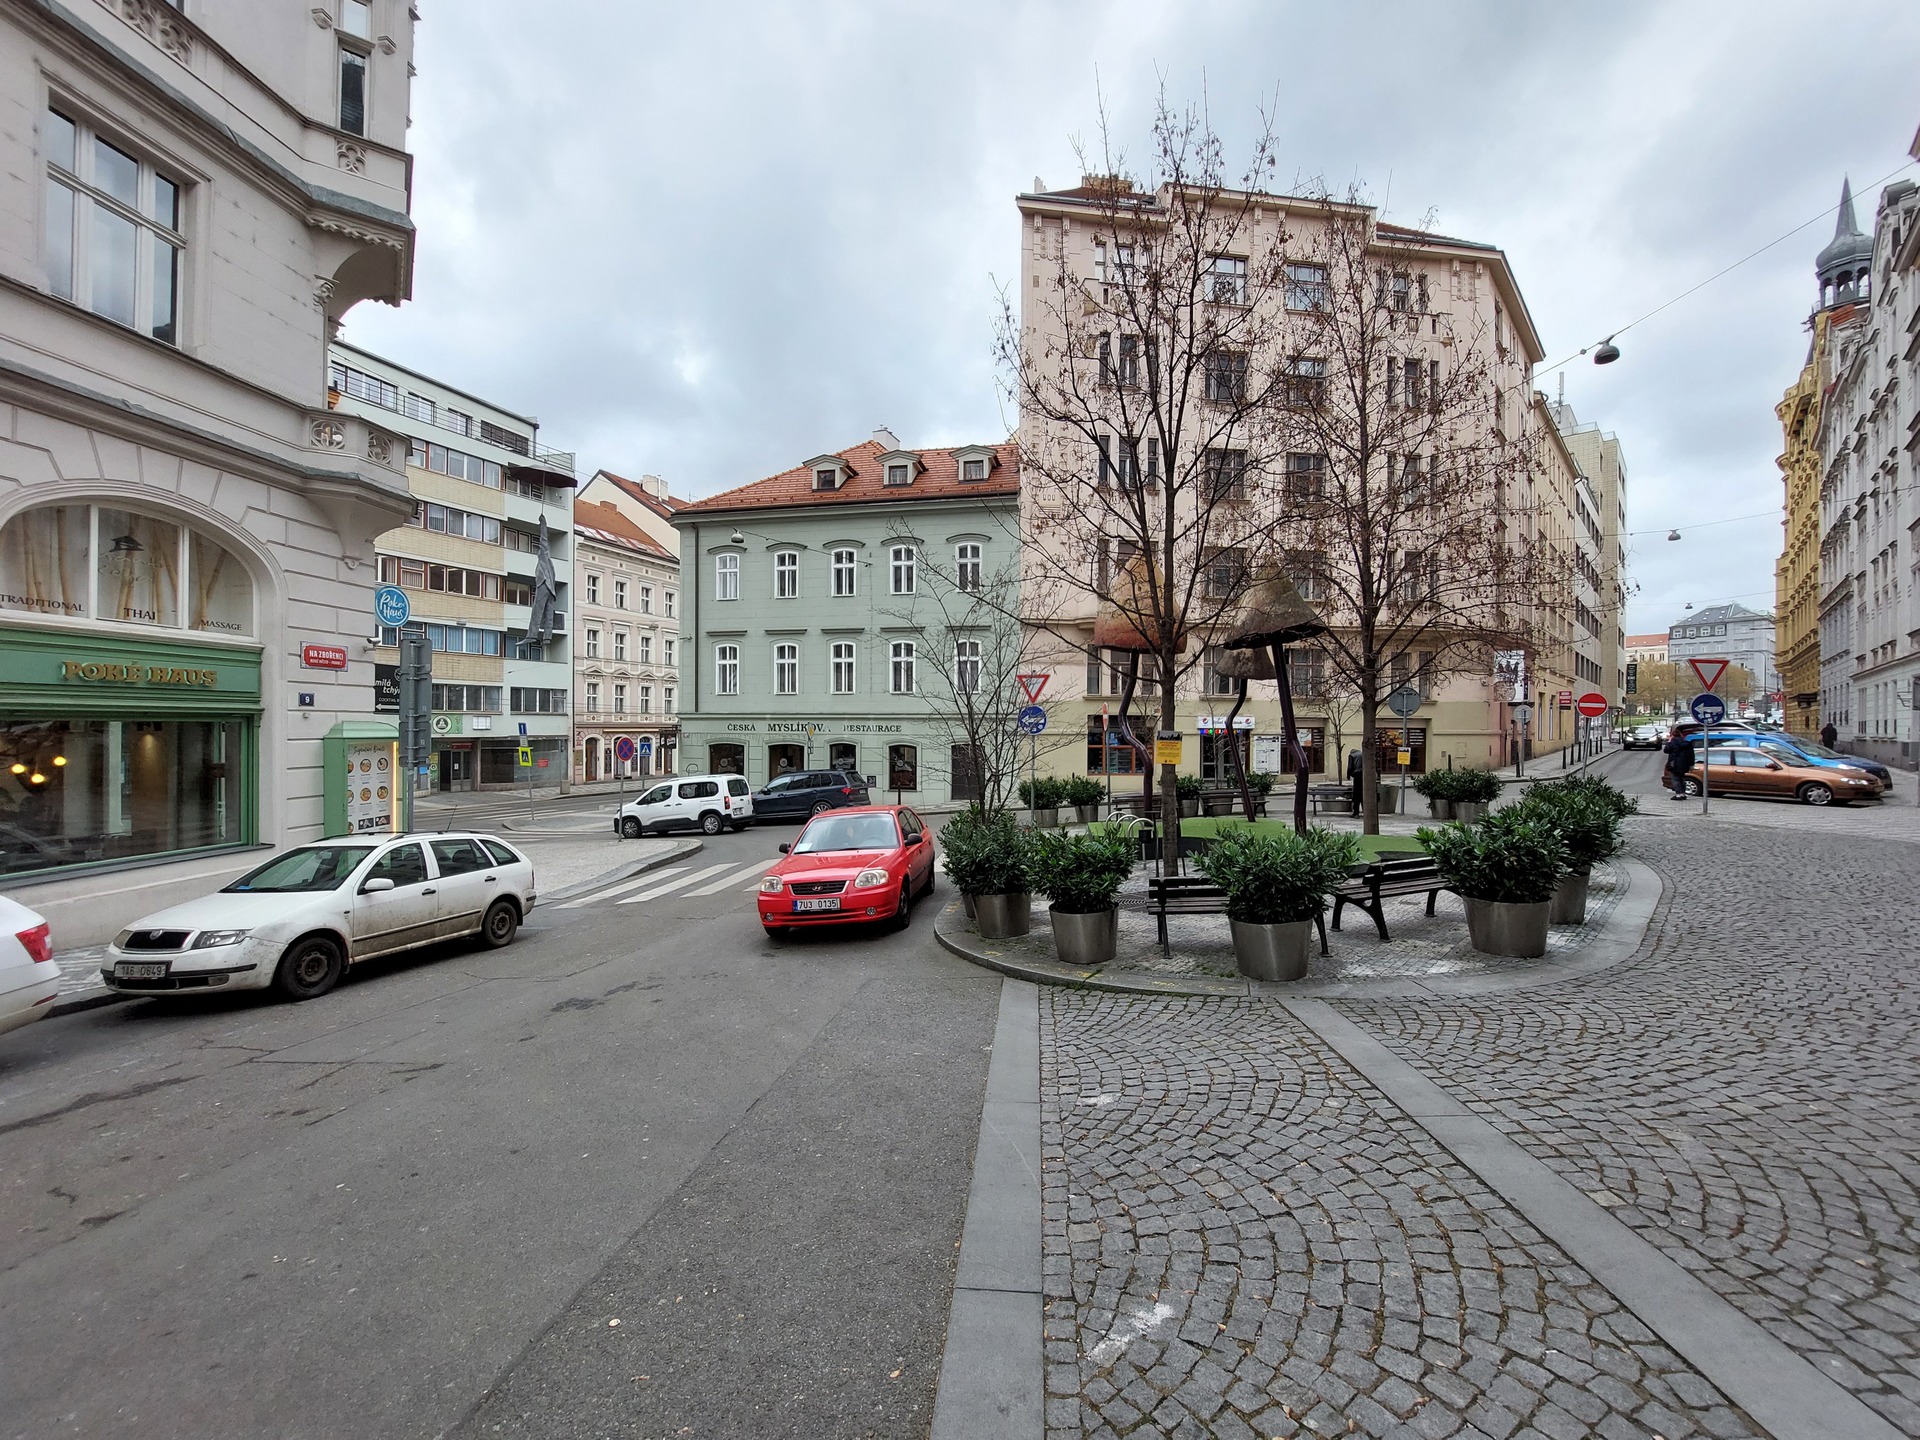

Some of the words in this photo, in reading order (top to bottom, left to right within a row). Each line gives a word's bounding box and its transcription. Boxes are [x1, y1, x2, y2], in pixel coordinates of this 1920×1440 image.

[0, 593, 85, 613] TRADITIONAL
[124, 607, 156, 621] THAI
[201, 619, 242, 631] MASSAGE
[383, 604, 404, 619] Haus
[309, 649, 318, 658] NA
[62, 660, 143, 684] POKÉ
[147, 666, 217, 687] HAUS
[375, 678, 392, 687] milá
[305, 695, 310, 704] 9
[727, 722, 756, 731] ČESKÁ
[843, 724, 902, 733] RESTAURACE
[798, 900, 813, 909] 7U3
[817, 899, 837, 908] 0135
